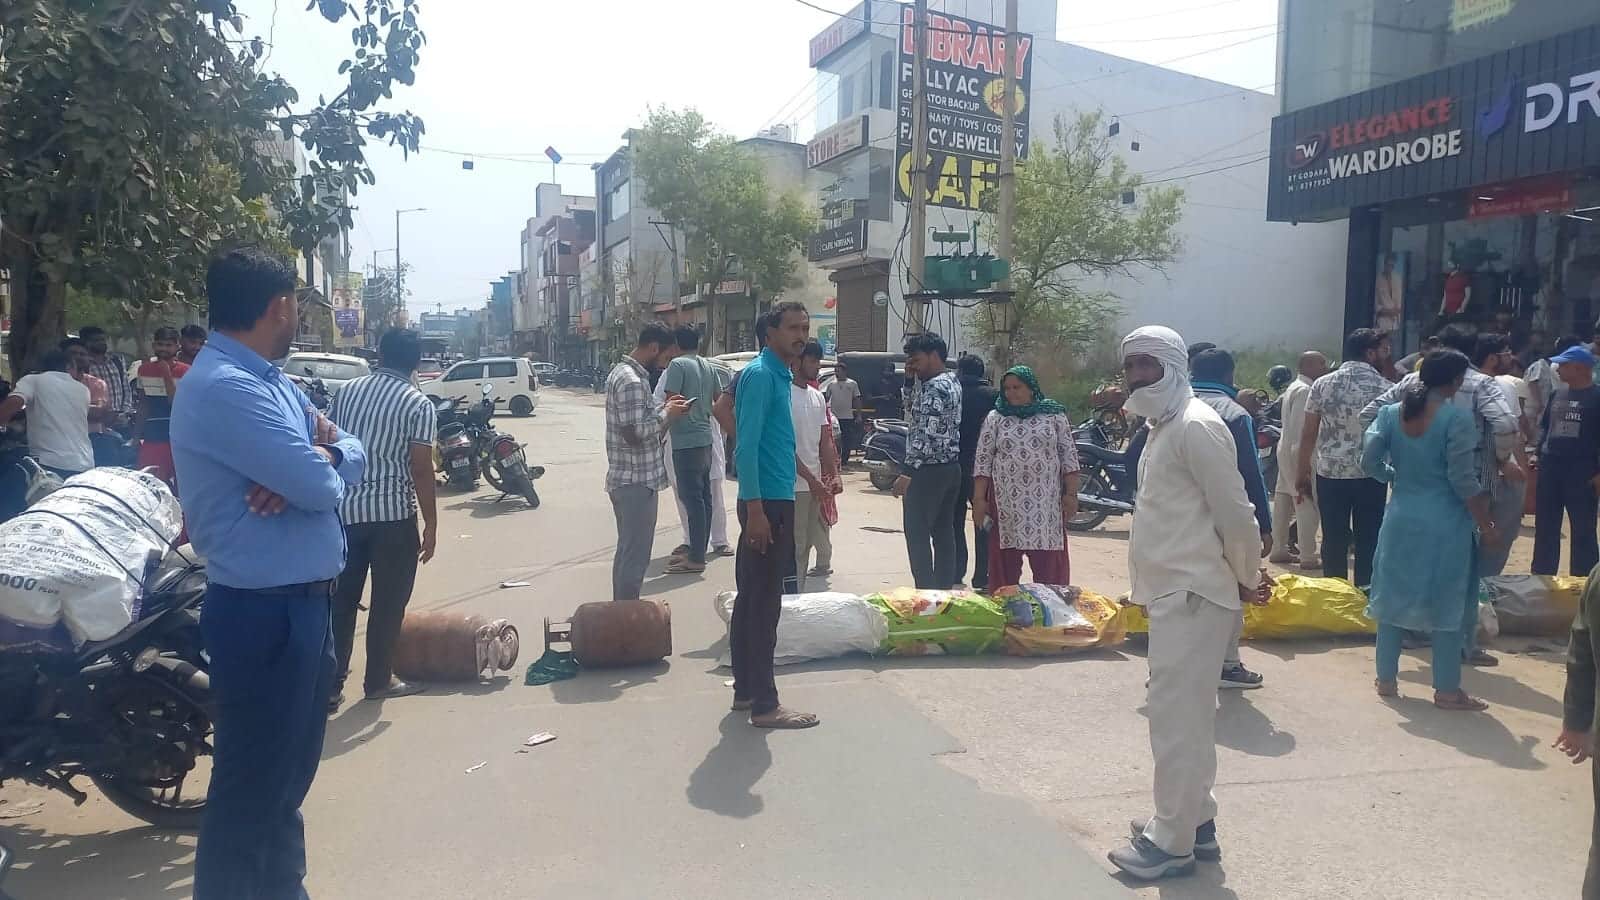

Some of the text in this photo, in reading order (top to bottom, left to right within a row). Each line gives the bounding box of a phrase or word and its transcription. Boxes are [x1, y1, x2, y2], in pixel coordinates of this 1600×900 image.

[902, 62, 954, 91] FLLY
[955, 75, 979, 97] AC
[902, 88, 980, 112] GETOR BACKUP
[901, 106, 951, 126] STNARY
[959, 118, 979, 131] TOYS
[1329, 98, 1454, 149] ELEGANCE
[808, 133, 840, 165] STORE
[900, 122, 1024, 158] FCY JEWELLY
[1328, 129, 1462, 180] WARDROBE
[898, 150, 1000, 210] CAF
[28, 545, 60, 556] DAIRY
